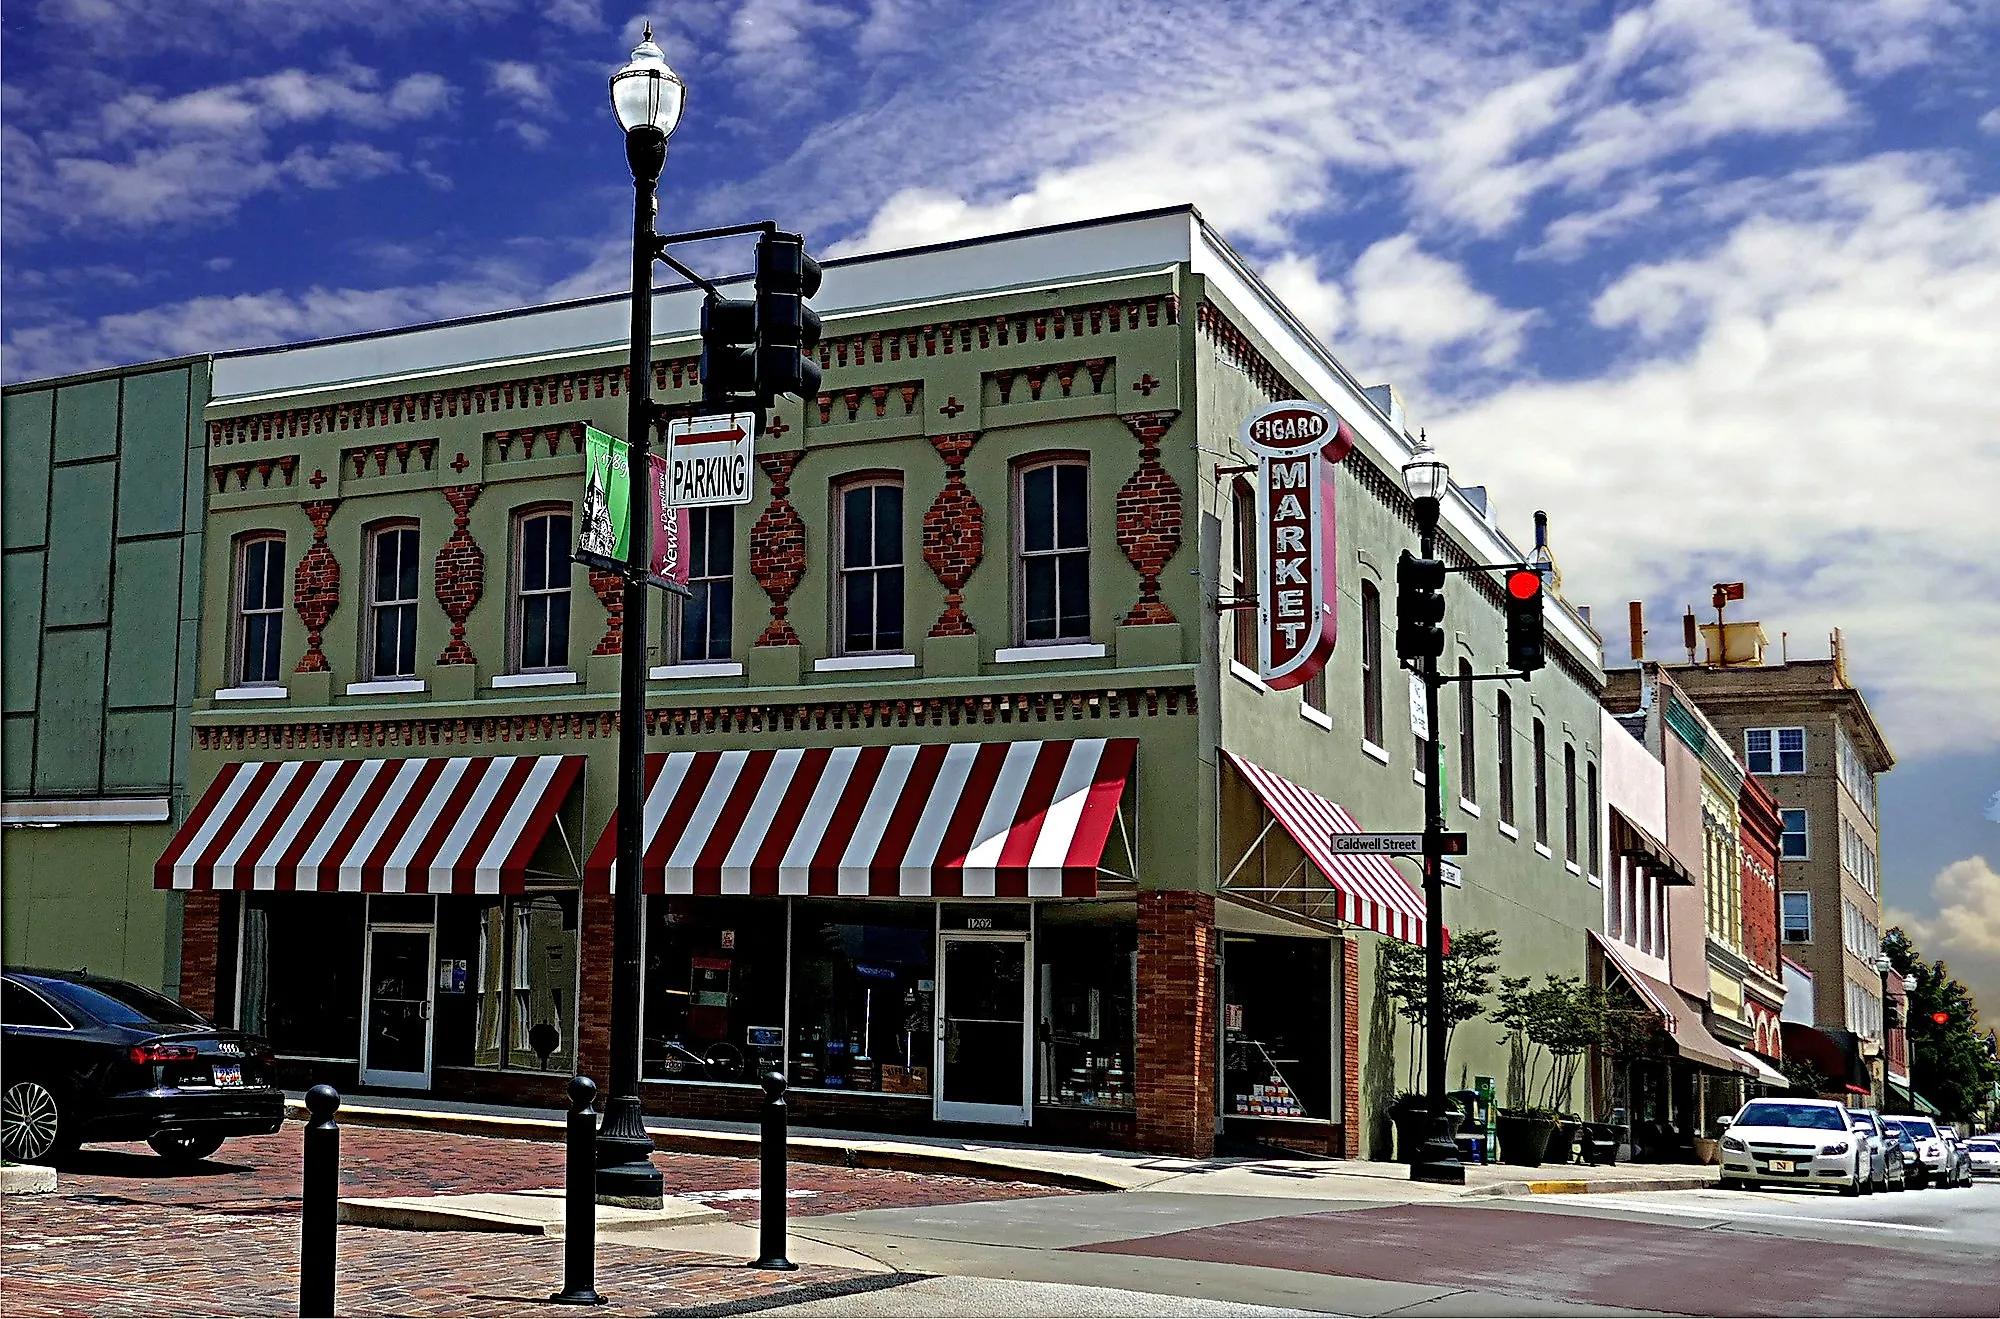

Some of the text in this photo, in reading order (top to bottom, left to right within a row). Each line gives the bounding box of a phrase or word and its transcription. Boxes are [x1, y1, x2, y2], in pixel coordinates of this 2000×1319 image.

[1256, 416, 1322, 440] FIGARO
[602, 453, 629, 478] 1789
[673, 454, 745, 500] PARKING
[1272, 461, 1307, 649] MARKET
[1336, 837, 1417, 850] Caldwell Street
[967, 918, 992, 929] 1202
